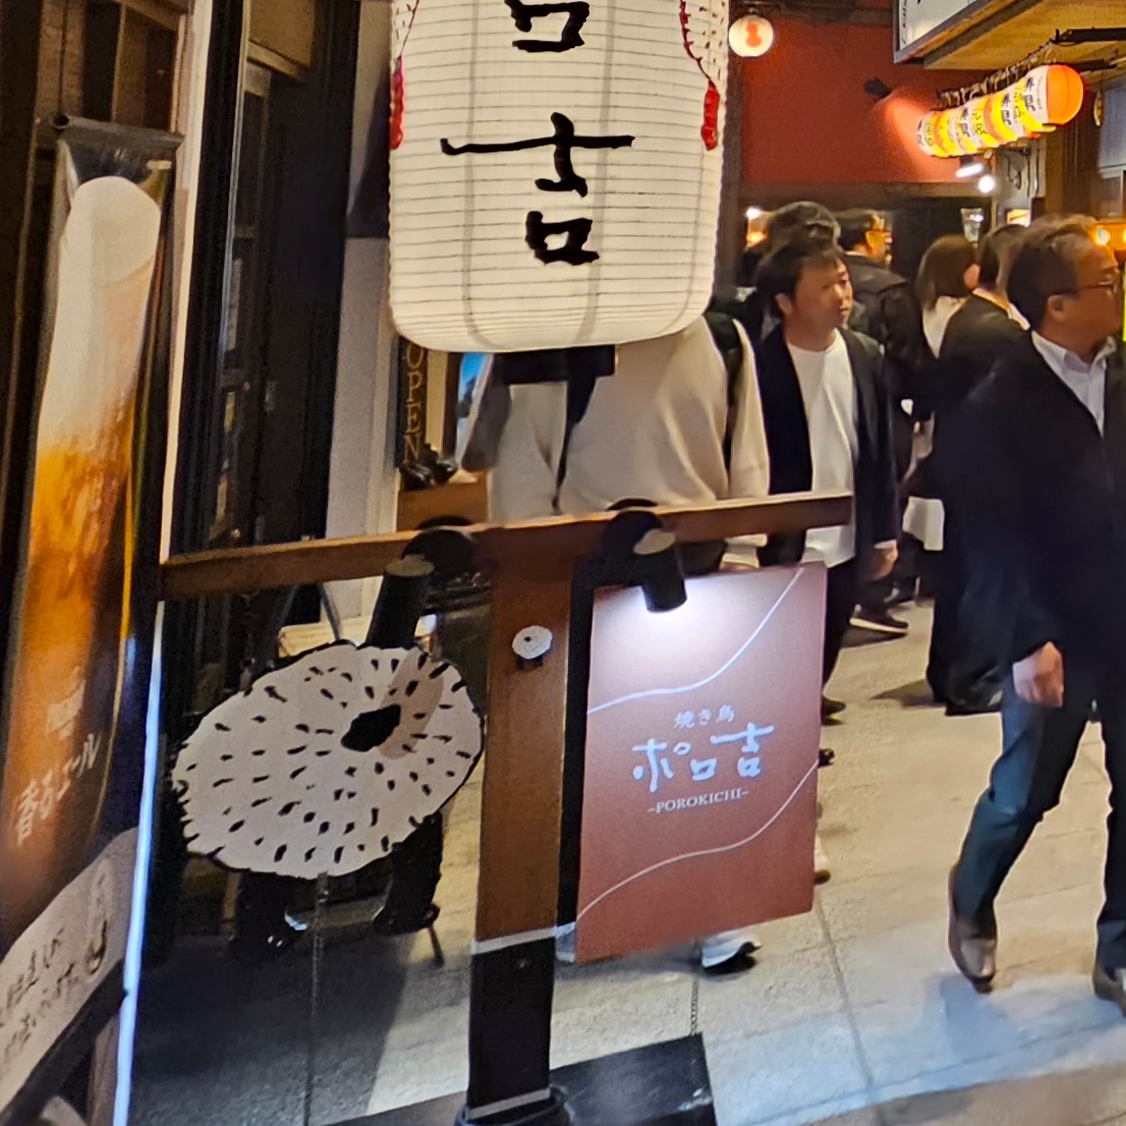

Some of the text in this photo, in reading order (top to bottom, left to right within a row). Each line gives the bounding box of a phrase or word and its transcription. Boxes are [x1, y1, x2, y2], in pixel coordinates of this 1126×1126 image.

[404, 343, 425, 463] OPEN
[631, 722, 775, 793] ポロ吉
